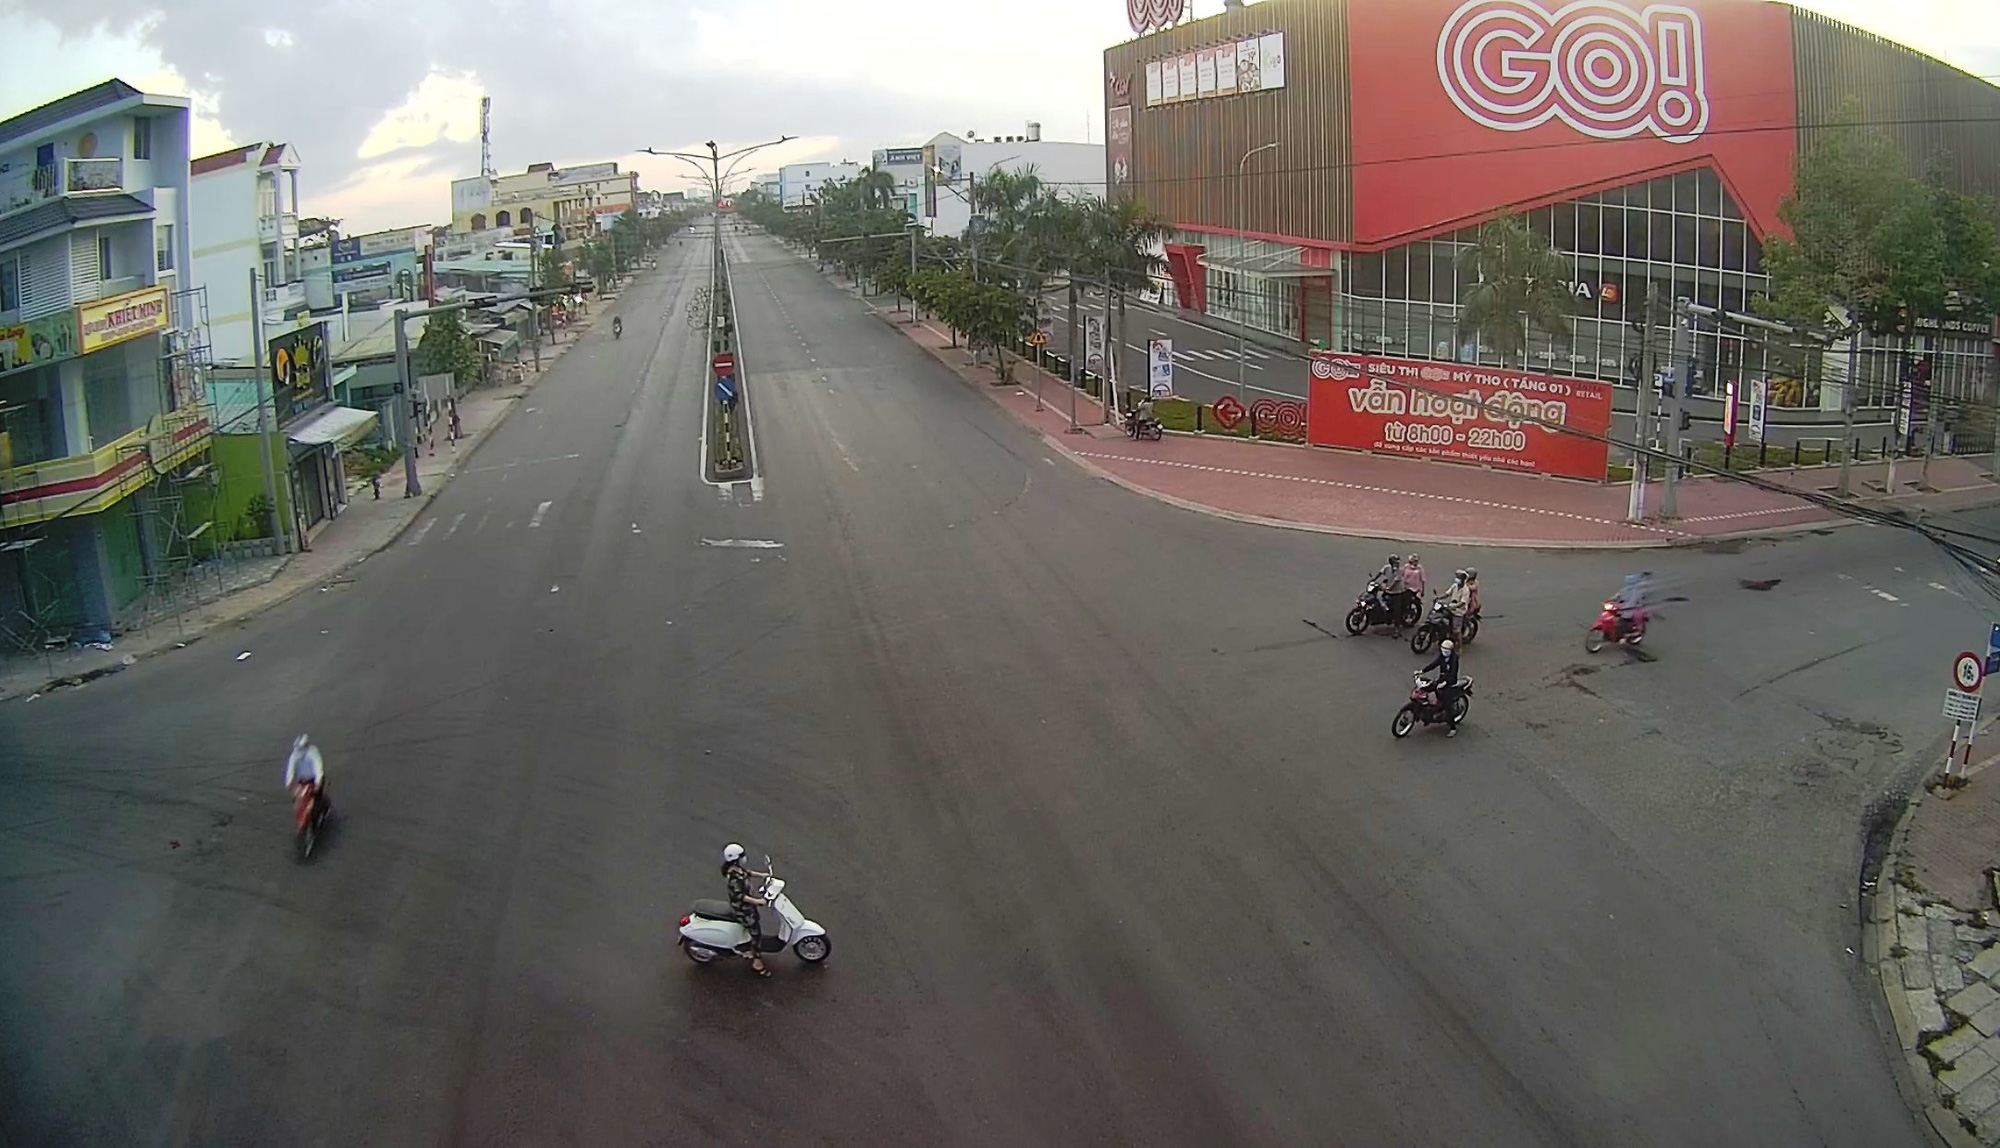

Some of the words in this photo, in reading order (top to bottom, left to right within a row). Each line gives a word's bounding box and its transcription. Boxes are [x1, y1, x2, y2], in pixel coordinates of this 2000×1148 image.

[1436, 0, 1708, 144] GO!
[1962, 322, 1990, 334] COFFEE
[1368, 362, 1396, 375] SIÊU
[1474, 374, 1501, 386] THO
[1348, 379, 1407, 414] vẫn
[1410, 388, 1482, 425] hoạt
[1484, 389, 1567, 433] động
[1576, 390, 1603, 400] RETAIL
[1384, 421, 1406, 443] từ
[1407, 424, 1453, 445] 8h00
[1467, 428, 1526, 451] 22h00
